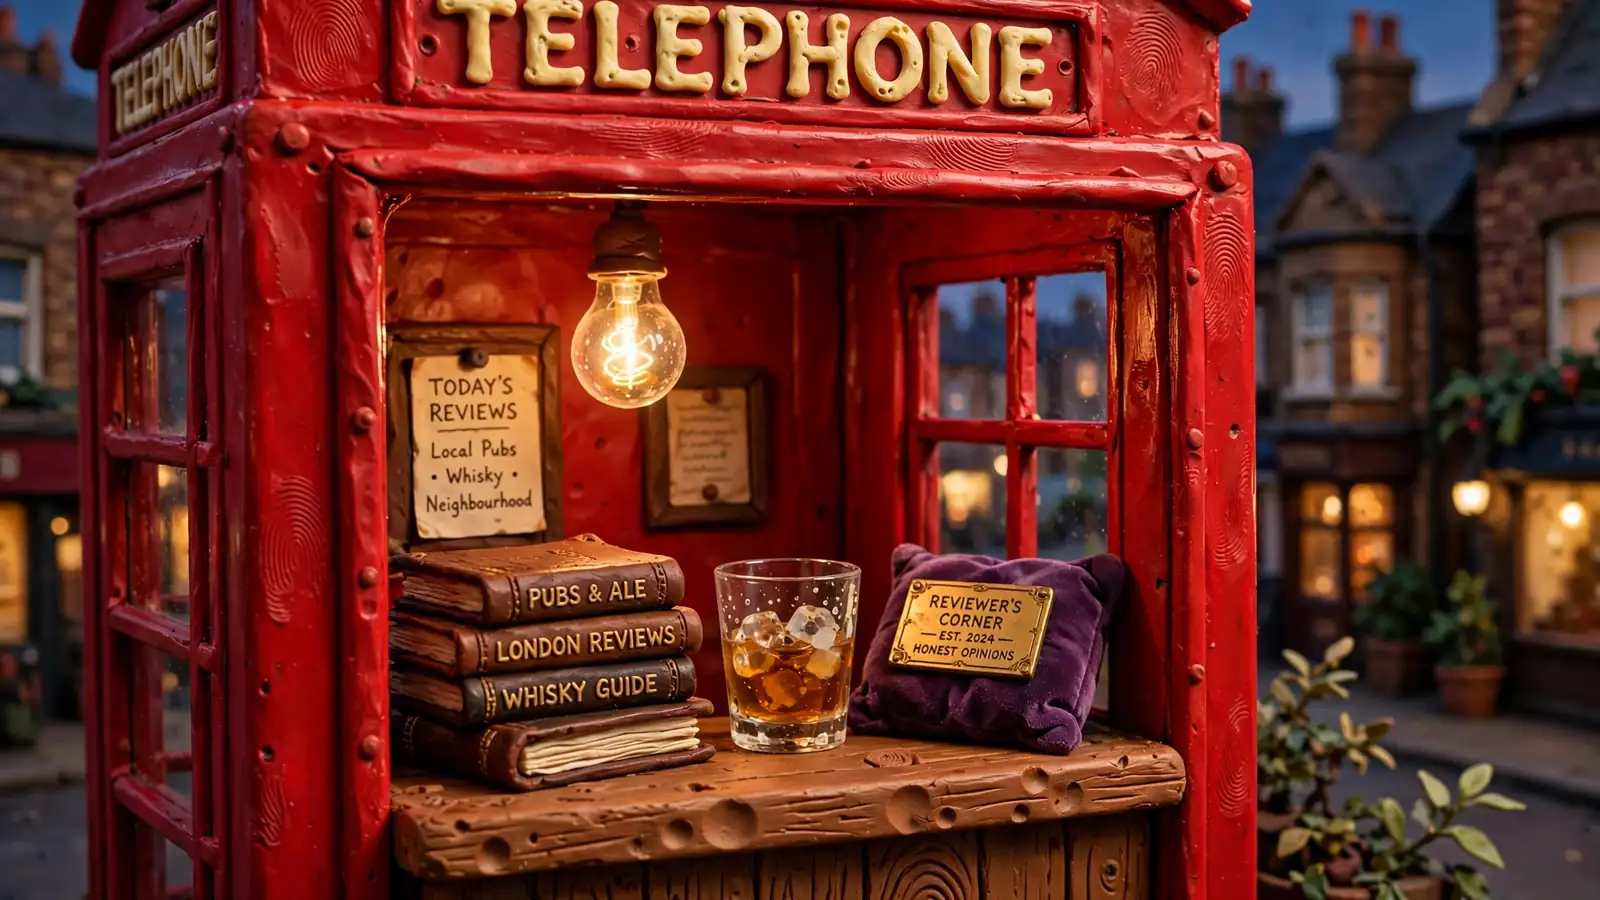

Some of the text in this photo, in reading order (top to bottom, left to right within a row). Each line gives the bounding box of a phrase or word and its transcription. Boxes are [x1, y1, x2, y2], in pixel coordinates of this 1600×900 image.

[436, 0, 1054, 108] TELEPHONE
[111, 10, 218, 133] TELEPHONE
[428, 375, 514, 396] TODAY'S
[430, 402, 518, 422] REVIEWS
[431, 439, 517, 459] Local Pubs
[446, 466, 503, 489] Whisky
[426, 489, 532, 518] Neighbourhood
[528, 579, 647, 610] PUBS & ALE
[929, 594, 1022, 614] REVIEWER'S
[939, 613, 1004, 629] CORNER
[497, 625, 675, 662] LONDON REVIEWS
[939, 631, 995, 644] EST. 2024
[913, 643, 1015, 661] HONEST OPINIONS
[502, 673, 658, 710] WHISKY GUIDE
